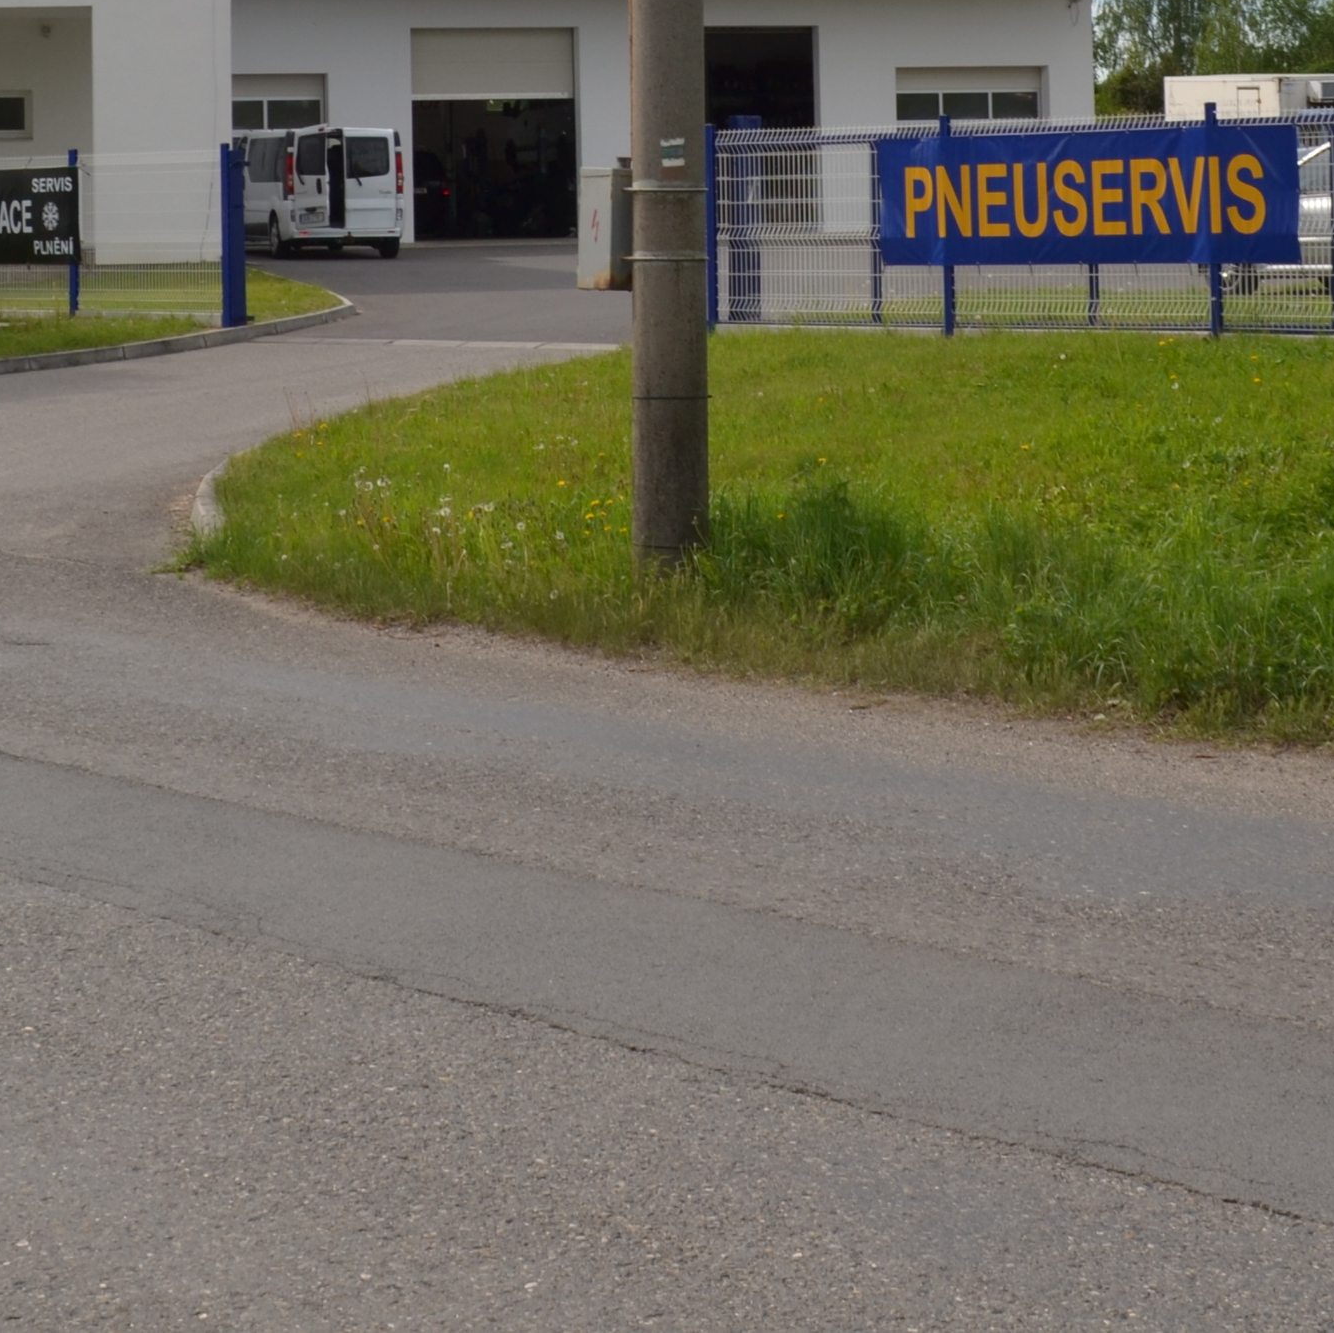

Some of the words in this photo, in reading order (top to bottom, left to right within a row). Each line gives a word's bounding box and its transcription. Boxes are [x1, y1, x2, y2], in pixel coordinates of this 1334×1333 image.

[31, 176, 73, 193] SERVIS
[904, 153, 1266, 239] PNEUSERVIS
[33, 237, 74, 255] PLNĚNÍ
